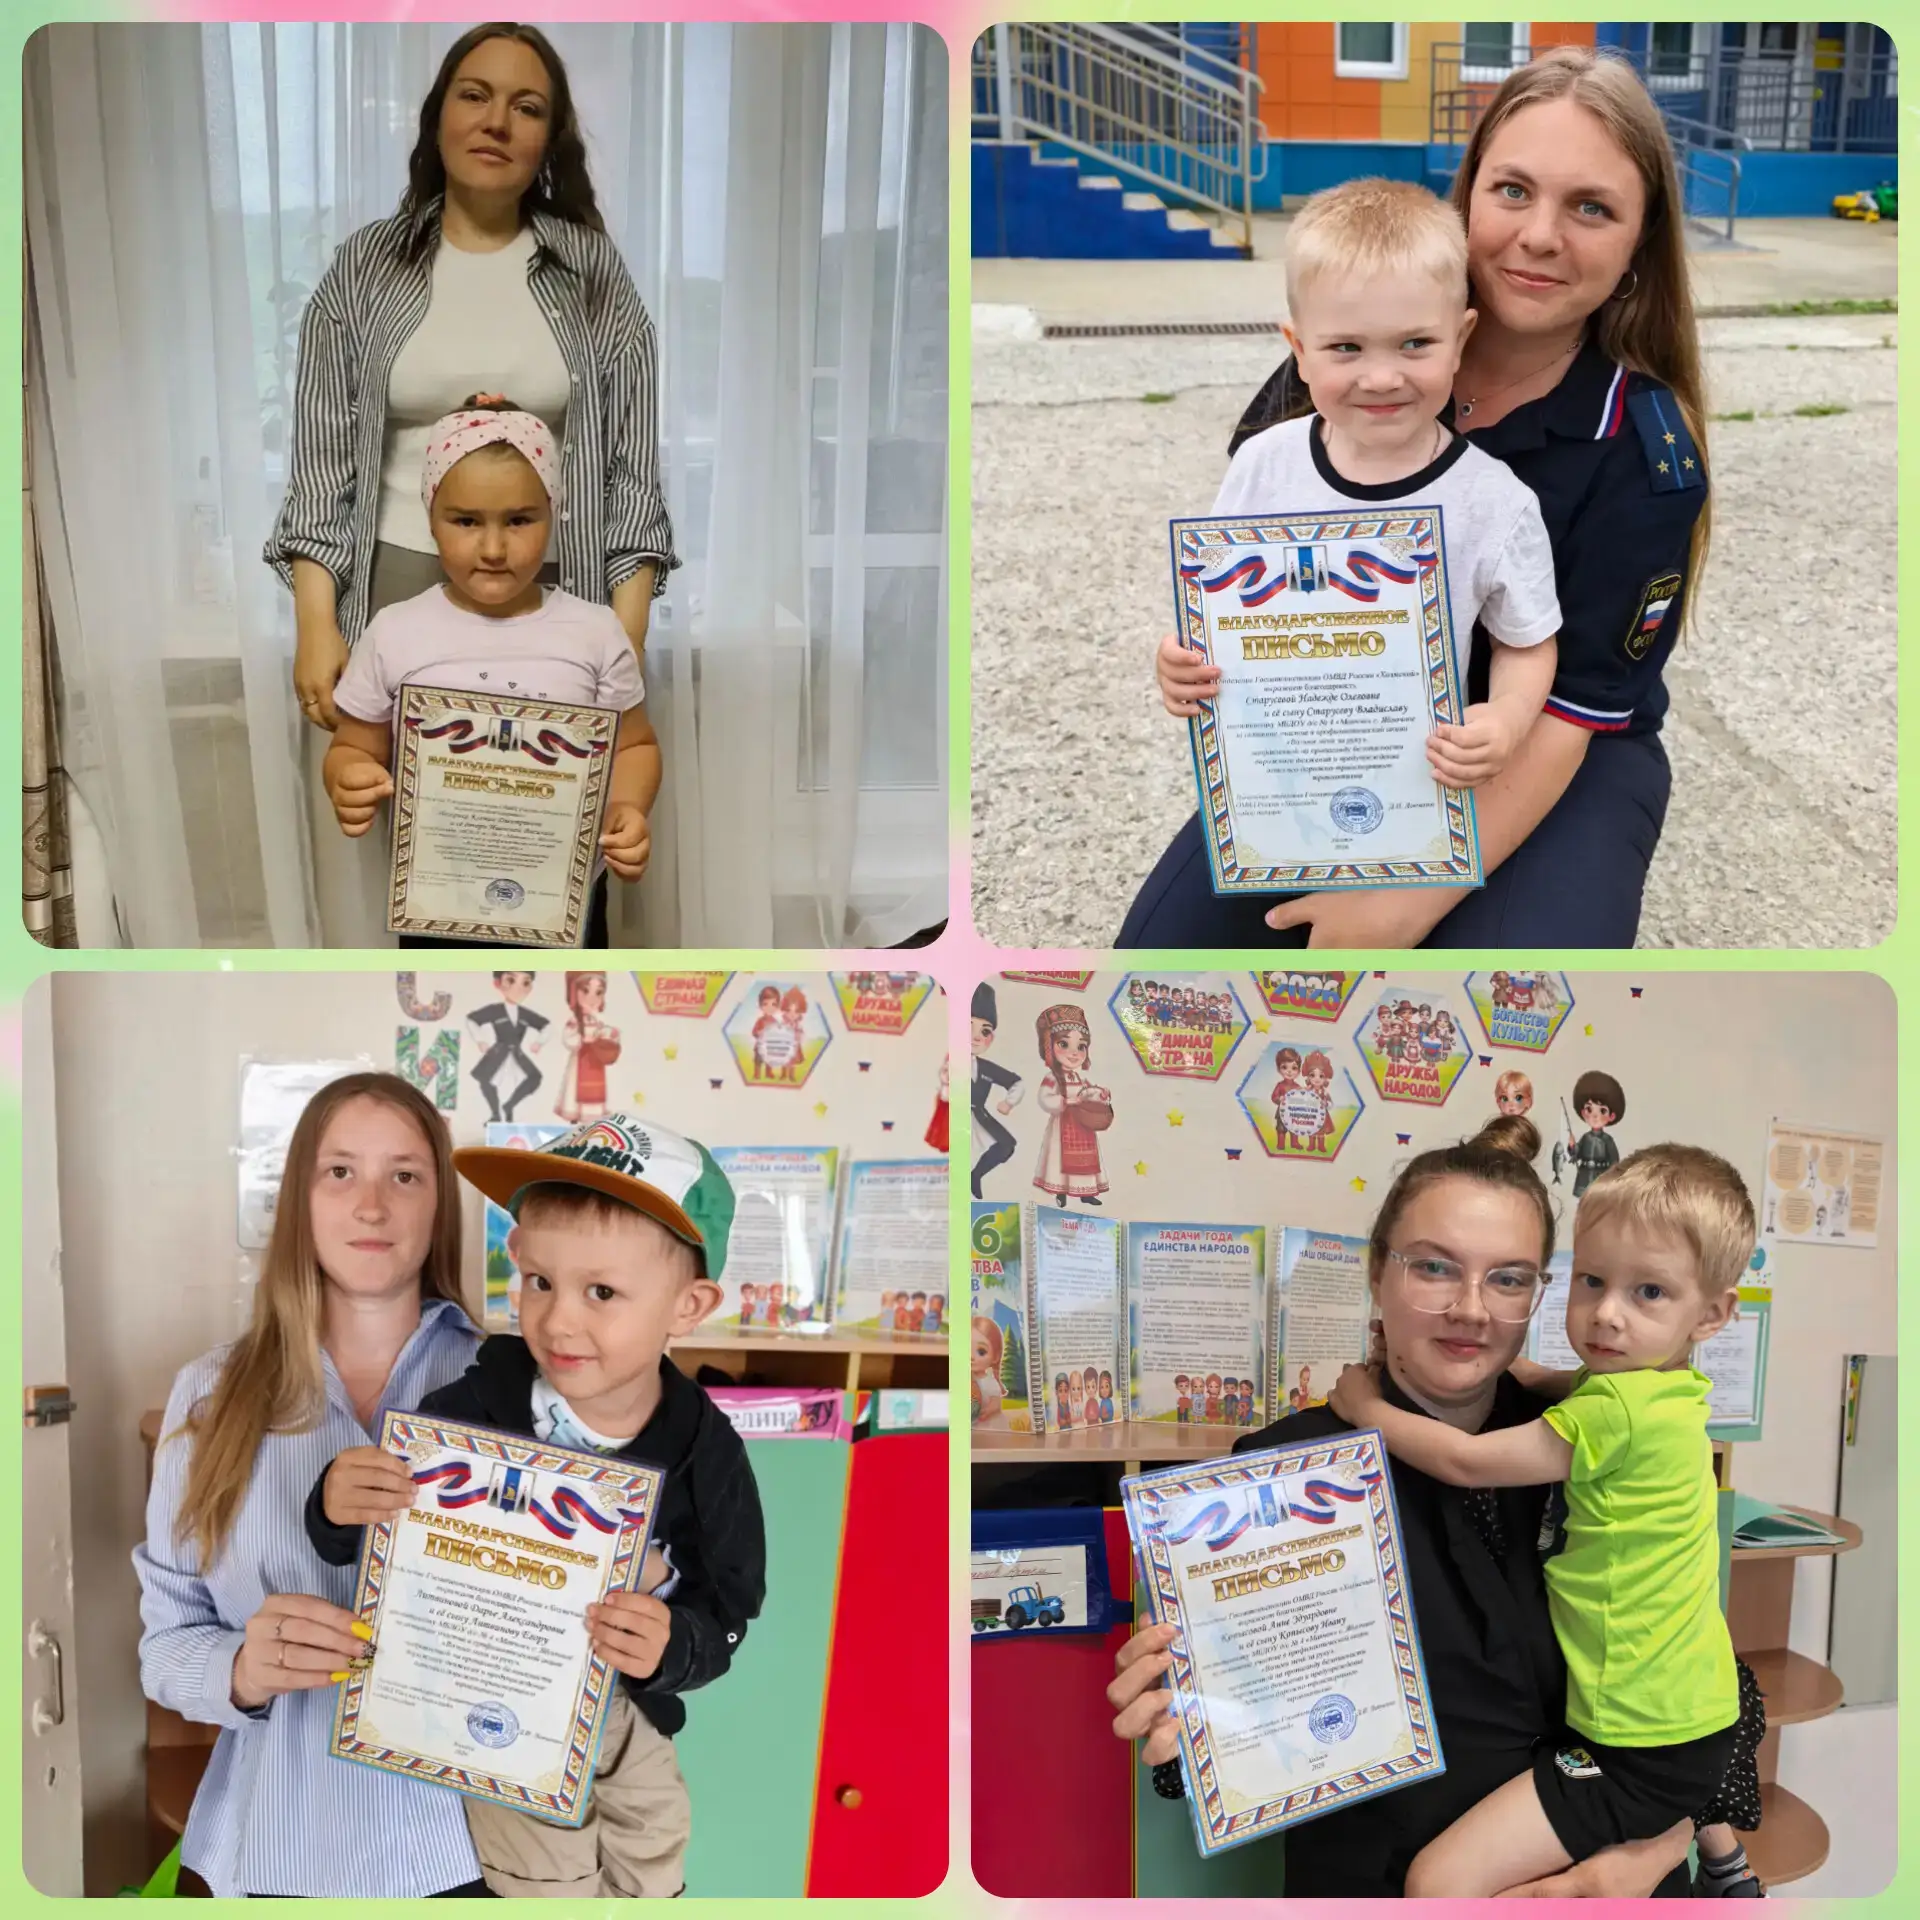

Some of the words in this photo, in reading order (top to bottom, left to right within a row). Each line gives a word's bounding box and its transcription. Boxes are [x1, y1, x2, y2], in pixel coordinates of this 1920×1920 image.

[1217, 609, 1410, 631] БЛАГОДАРСТВЕННОЕ
[1241, 631, 1386, 660] ПИСЬМО
[1245, 694, 1296, 707] Старусевой
[1298, 692, 1338, 704] Надежде
[1340, 692, 1381, 702] Олеговне
[1306, 706, 1354, 718] Старусеву
[1355, 703, 1409, 715] Владиславу
[443, 771, 556, 800] ПИСЬМО
[1268, 971, 1341, 1012] 2026
[1491, 1007, 1550, 1029] БОГАТСТВО
[1152, 1031, 1214, 1049] ДИНАЯ
[1491, 1021, 1549, 1046] КУЛЬТУР
[1385, 1062, 1440, 1082] ДРУЖБА
[1383, 1079, 1441, 1099] НАРОДОВ
[1159, 1230, 1200, 1242] ЗАДАЧИ
[1205, 1231, 1234, 1243] ГОДА
[1143, 1241, 1197, 1254] ЕДИНСТВА
[1199, 1243, 1250, 1255] НАРОДОВ
[1299, 1249, 1315, 1260] НАШ
[1316, 1250, 1343, 1262] ОБЩИЙ
[408, 1508, 599, 1570] БЛАГОДАРСТВЕННОЕ
[424, 1532, 567, 1590] ПИСЬМО
[1186, 1524, 1364, 1580] БЛАГОДАРСТВЕННОЕ
[1212, 1549, 1346, 1602] ПИСЬМО
[470, 1603, 498, 1618] Дарье
[1320, 1616, 1347, 1629] Ивану
[522, 1629, 550, 1645] Егору
